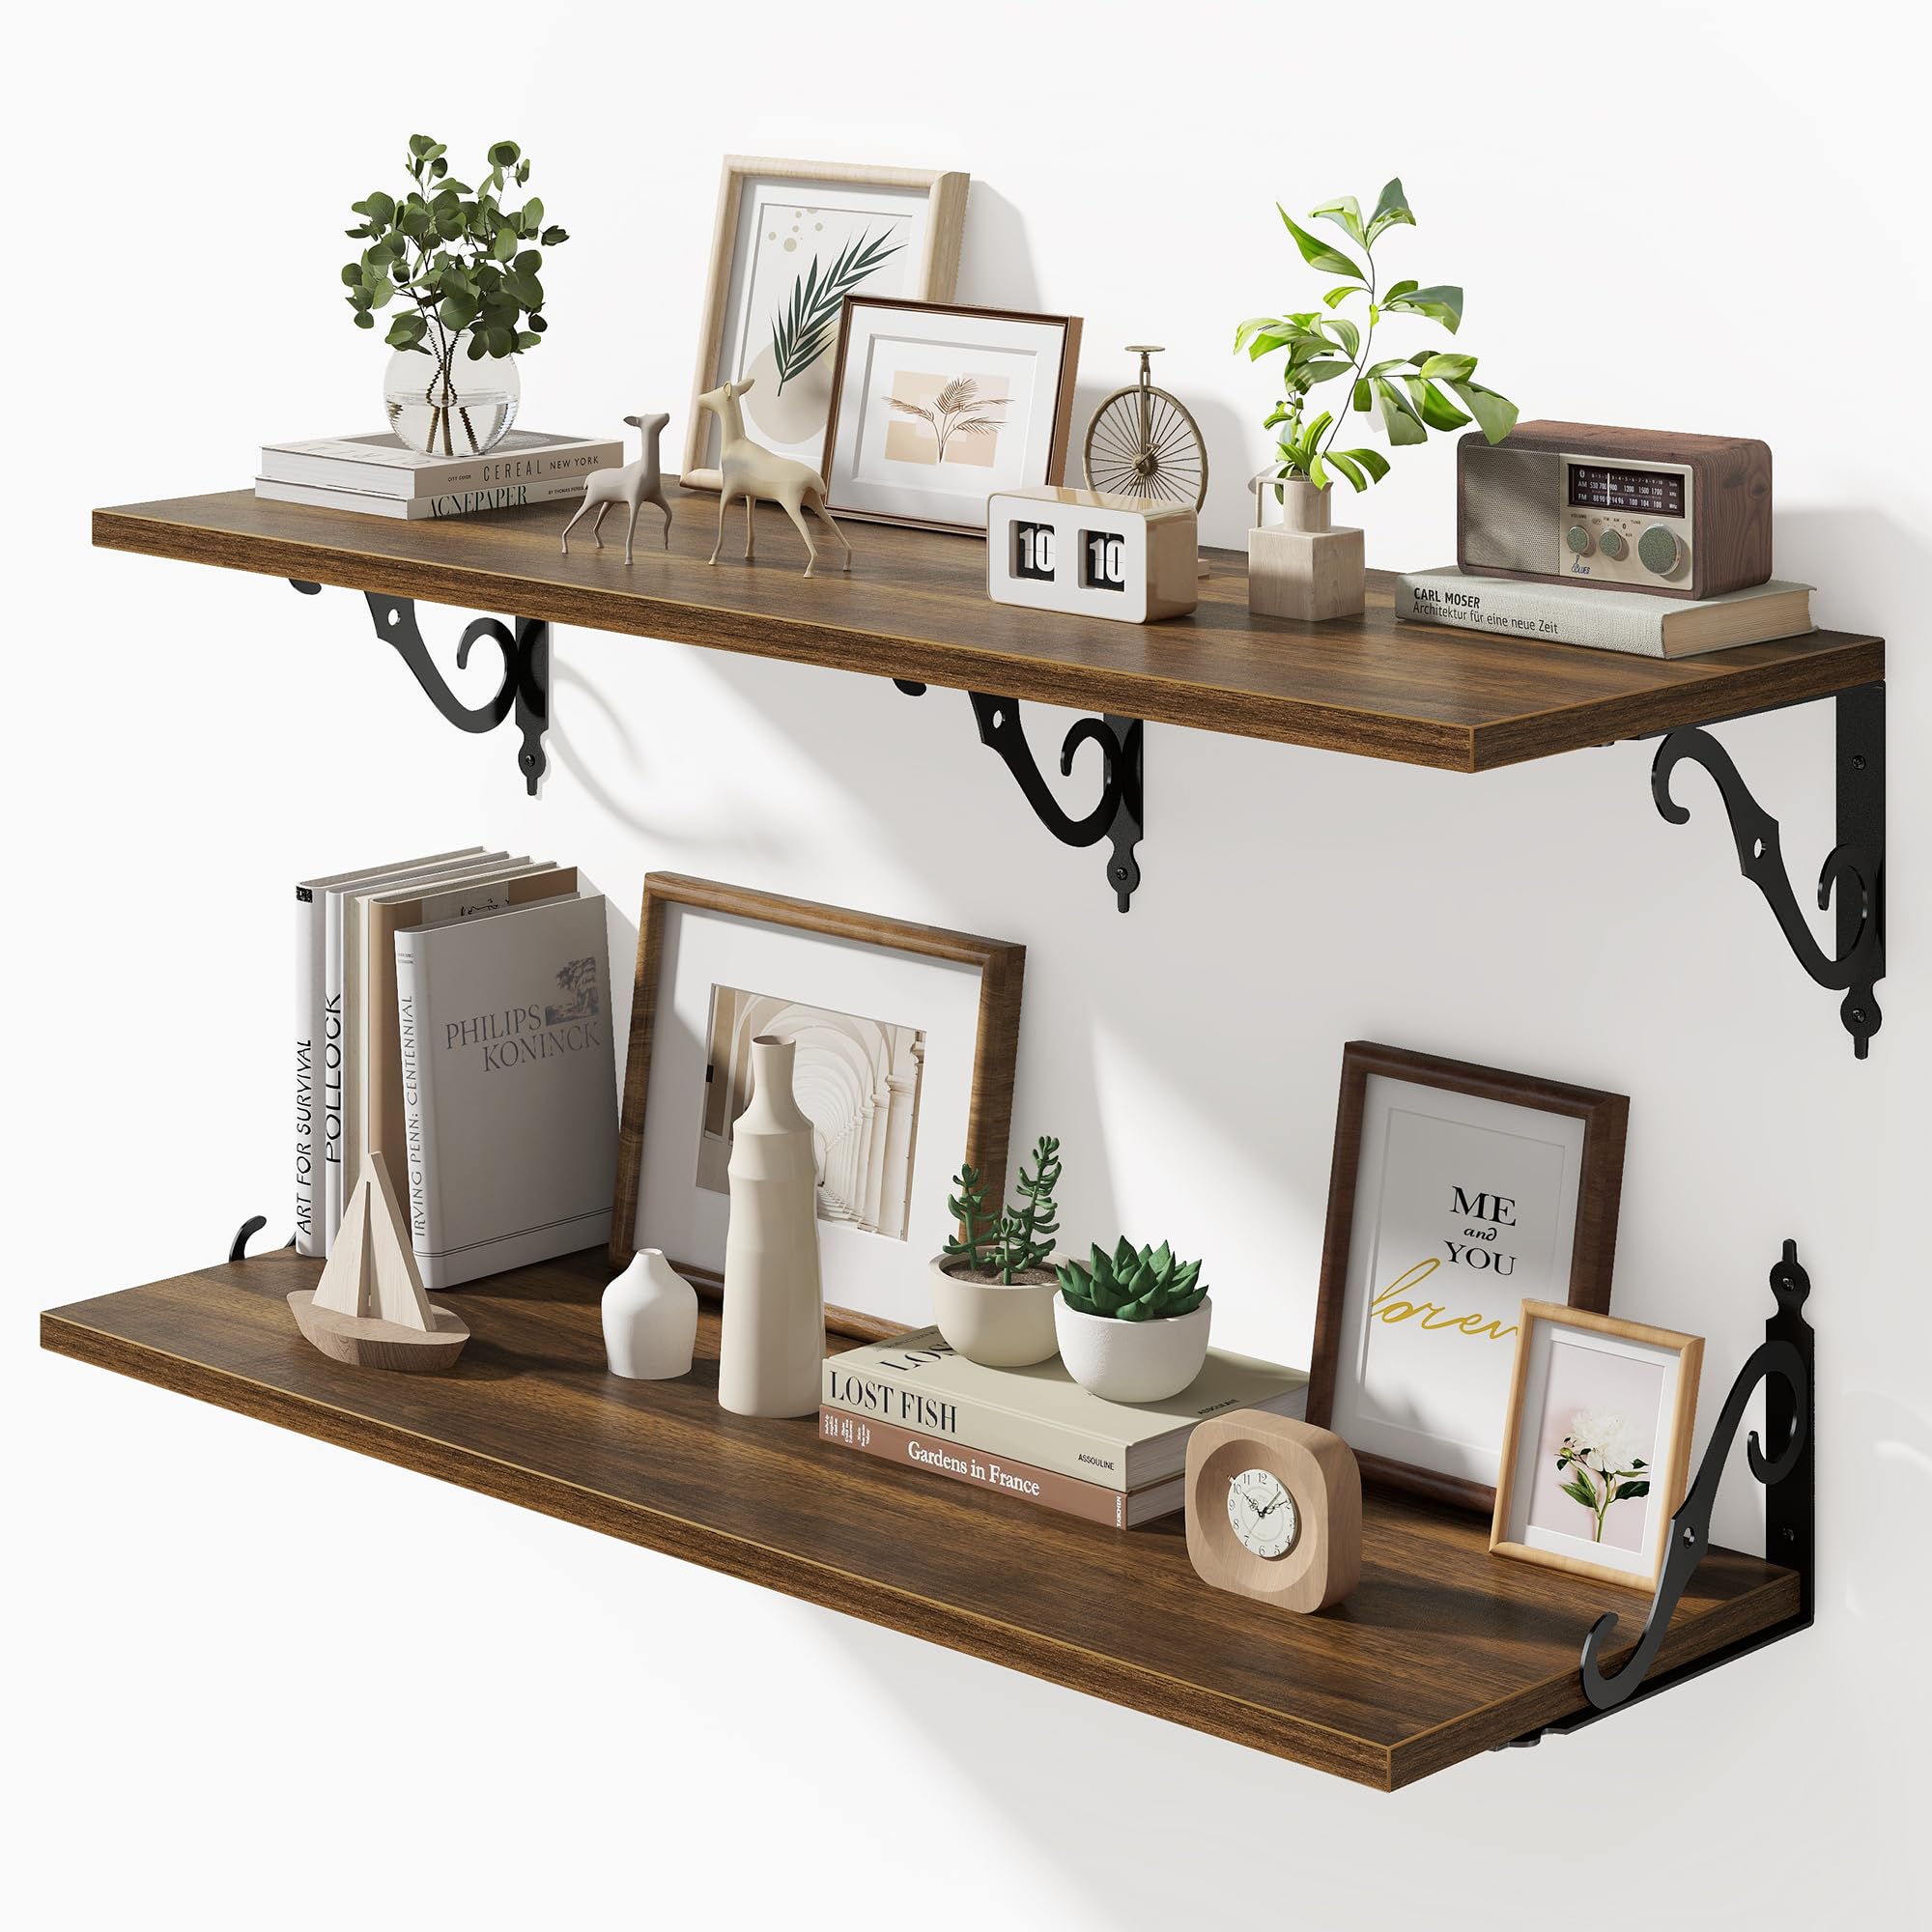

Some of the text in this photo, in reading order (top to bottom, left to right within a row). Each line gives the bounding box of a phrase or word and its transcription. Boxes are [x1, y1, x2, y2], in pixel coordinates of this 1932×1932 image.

[484, 460, 542, 482] CEREAL
[550, 458, 570, 469] NEW
[574, 455, 599, 468] YORK
[1651, 487, 1662, 496] 1700
[1019, 528, 1055, 572] 10
[1089, 538, 1124, 583] 10
[1414, 587, 1480, 609] CARL MOSER
[1413, 601, 1558, 634] Architektur für eine neue Zeit
[445, 1004, 542, 1050] PHILIPS
[483, 1021, 602, 1072] KONINCK
[326, 994, 341, 1163] POLLOCK
[401, 996, 425, 1236] IRVING PENN: CENTENNIAL
[297, 1040, 311, 1236] ART FOR SURVIVAL
[1449, 1185, 1517, 1227] ME
[1463, 1227, 1497, 1241] and
[1443, 1239, 1518, 1275] YOU
[875, 1341, 957, 1371] LOS
[830, 1370, 895, 1414] LOST
[900, 1390, 957, 1434] FISH
[907, 1440, 1040, 1496] Gardens in France
[1078, 1453, 1115, 1471] ASSOULINE
[1233, 1483, 1242, 1494] 10
[1243, 1473, 1250, 1485] 11
[1259, 1472, 1267, 1485] 12
[1275, 1483, 1279, 1492] 1
[1229, 1499, 1236, 1511] 9
[1233, 1519, 1239, 1529] 8
[1244, 1534, 1250, 1547] 7
[1259, 1545, 1265, 1556] 6
[1274, 1545, 1280, 1555] 5
[1285, 1535, 1291, 1546] 4
